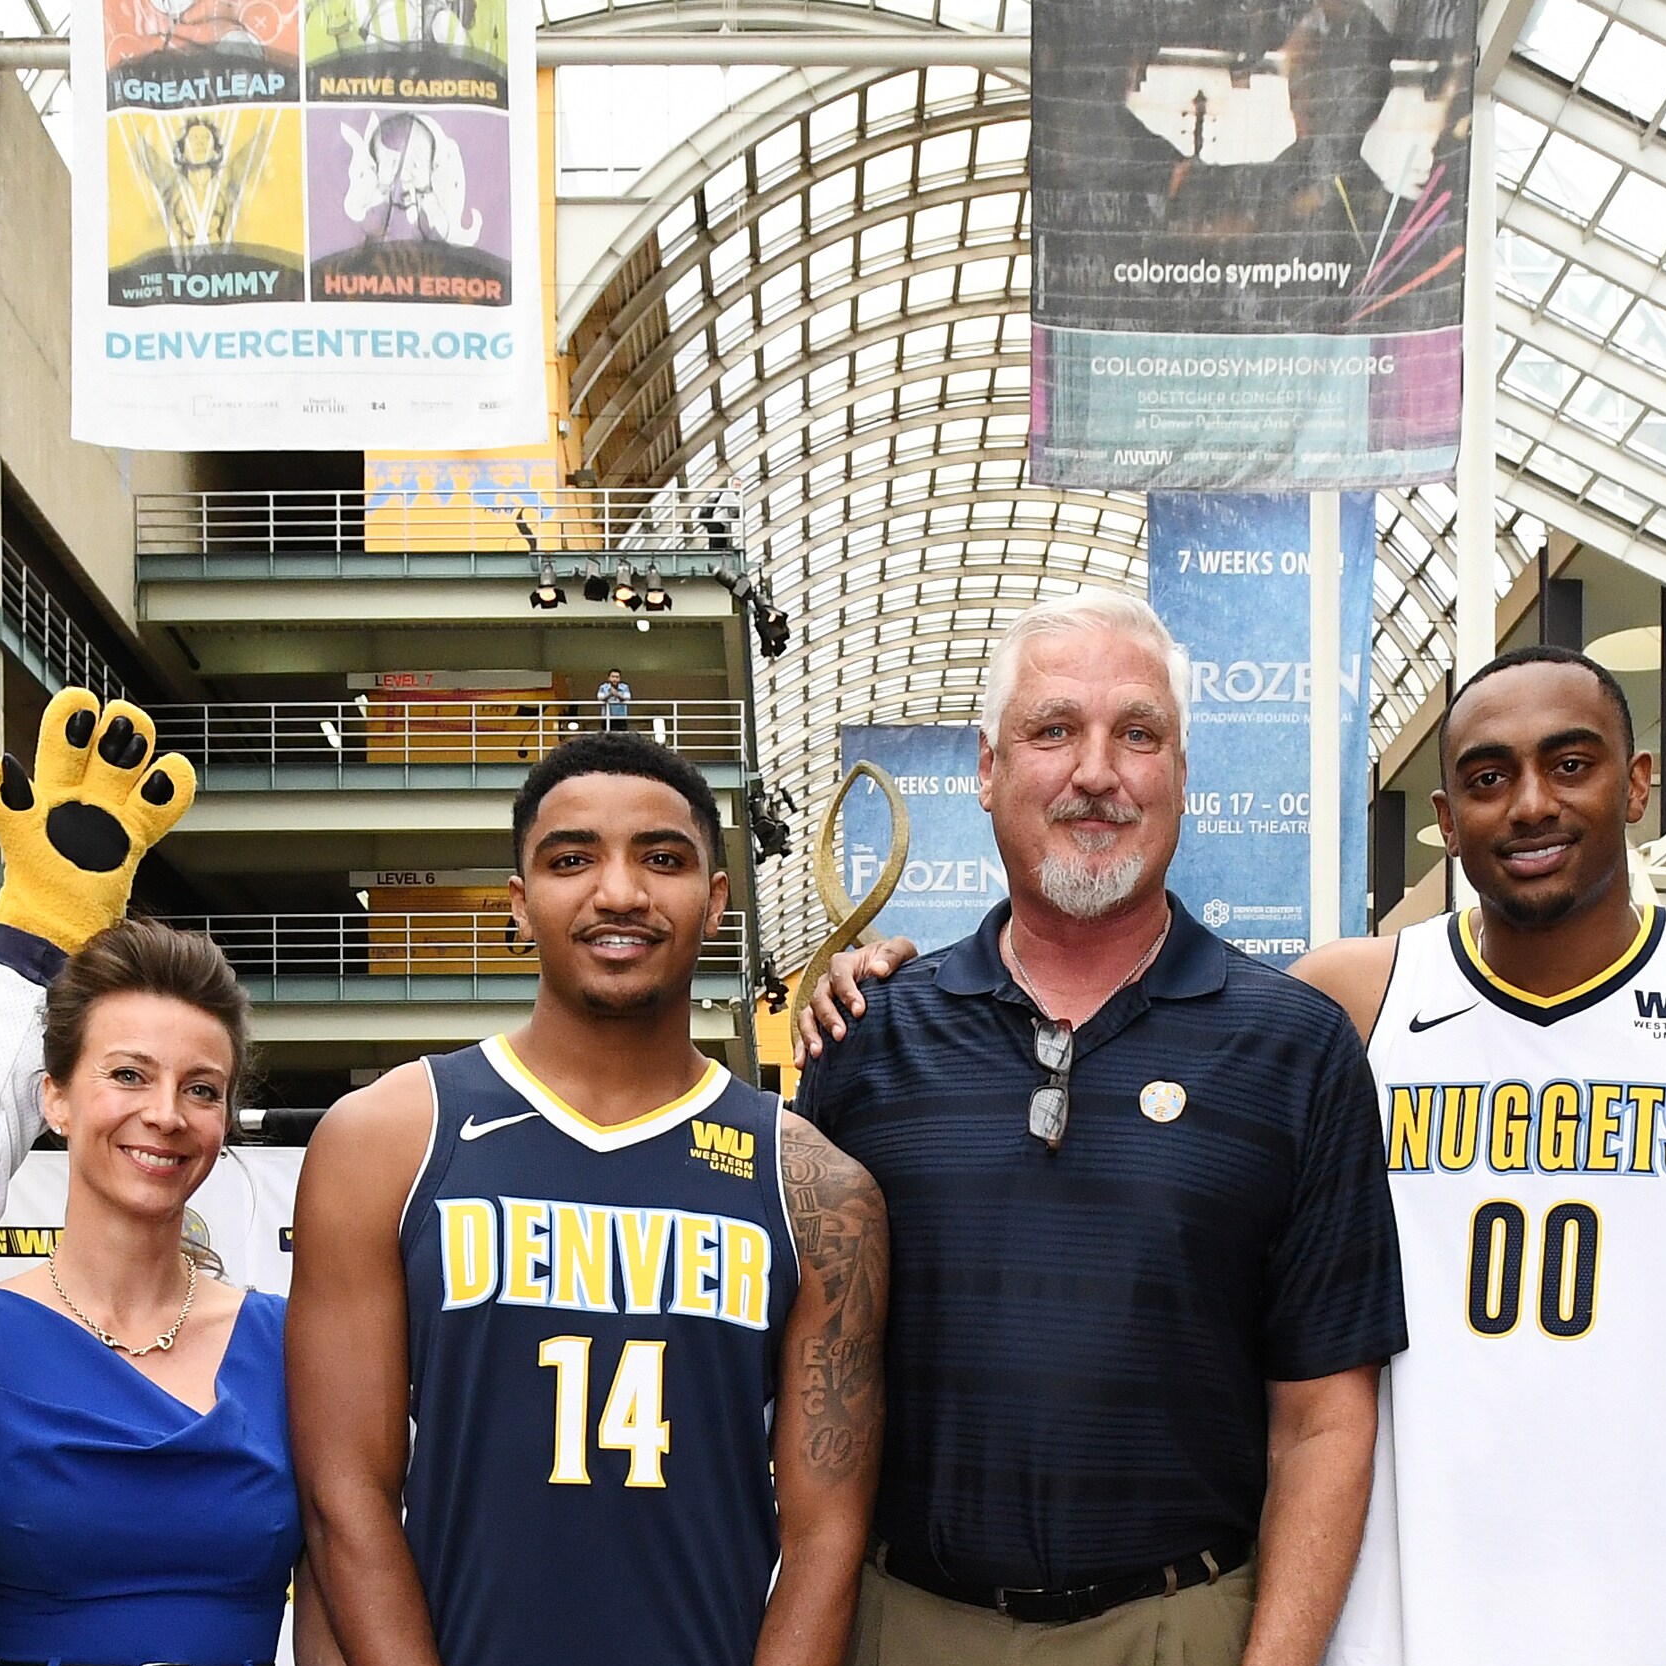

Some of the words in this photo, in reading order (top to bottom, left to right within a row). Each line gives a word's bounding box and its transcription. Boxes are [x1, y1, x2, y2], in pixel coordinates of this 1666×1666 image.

[124, 77, 210, 103] GREAT
[216, 73, 285, 98] LEAP
[320, 76, 395, 96] NATIVE
[399, 79, 498, 100] GARDENS
[140, 273, 162, 285] THE
[167, 270, 279, 298] TOMMY
[1114, 258, 1221, 285] colorado
[1226, 258, 1351, 289] symphony
[122, 285, 163, 299] WHO'S
[324, 274, 414, 296] HUMAN
[419, 276, 502, 300] ERROR
[105, 328, 513, 361] DENVERCENTER.ORG
[1091, 355, 1395, 377] COLORADOSYMPHONY.ORG
[1138, 390, 1226, 405] BOETTCHER
[1231, 390, 1302, 405] CONCERT
[1178, 550, 1191, 574] 7
[1199, 551, 1273, 575] WEEKS
[375, 673, 419, 687] LEVEL
[425, 673, 433, 686] 7
[1188, 711, 1299, 724] ROADWAY-BOUND
[866, 776, 877, 794] 7
[895, 776, 939, 795] EEKS
[944, 776, 980, 794] ONL
[1229, 793, 1254, 815] 17
[1197, 821, 1244, 834] BUELL
[377, 873, 421, 885] LEVEL
[426, 872, 435, 885] 6
[851, 855, 1010, 897] FOZEN
[691, 1119, 754, 1160] WU
[689, 1148, 753, 1171] WESTERN
[709, 1161, 753, 1180] UNION
[435, 1194, 770, 1331] DENVER
[1464, 1198, 1603, 1341] 00
[538, 1335, 671, 1488] 14
